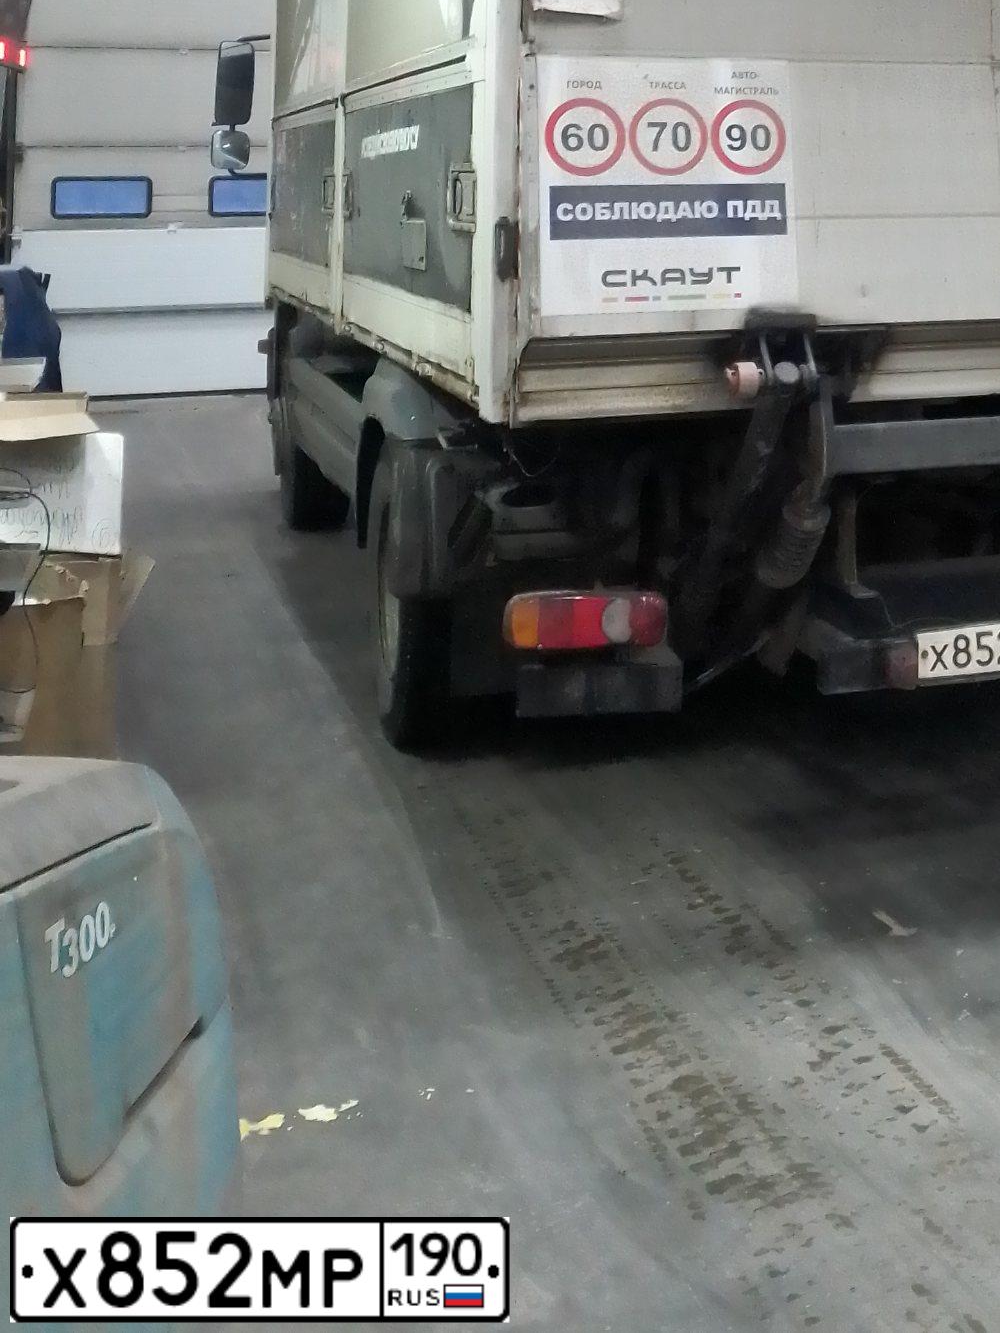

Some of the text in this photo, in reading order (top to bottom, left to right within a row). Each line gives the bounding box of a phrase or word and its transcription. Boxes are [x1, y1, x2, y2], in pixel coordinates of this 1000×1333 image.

[566, 80, 602, 91] ГОРОД
[649, 81, 687, 91] ТРАССА
[714, 86, 780, 96] МАГИСТРАЛЬ
[560, 123, 610, 152] 60
[647, 121, 692, 152] 70
[725, 123, 772, 152] 90
[556, 199, 782, 223] СОБЛЮДАЮ ПДД
[601, 266, 741, 288] СКАУТ
